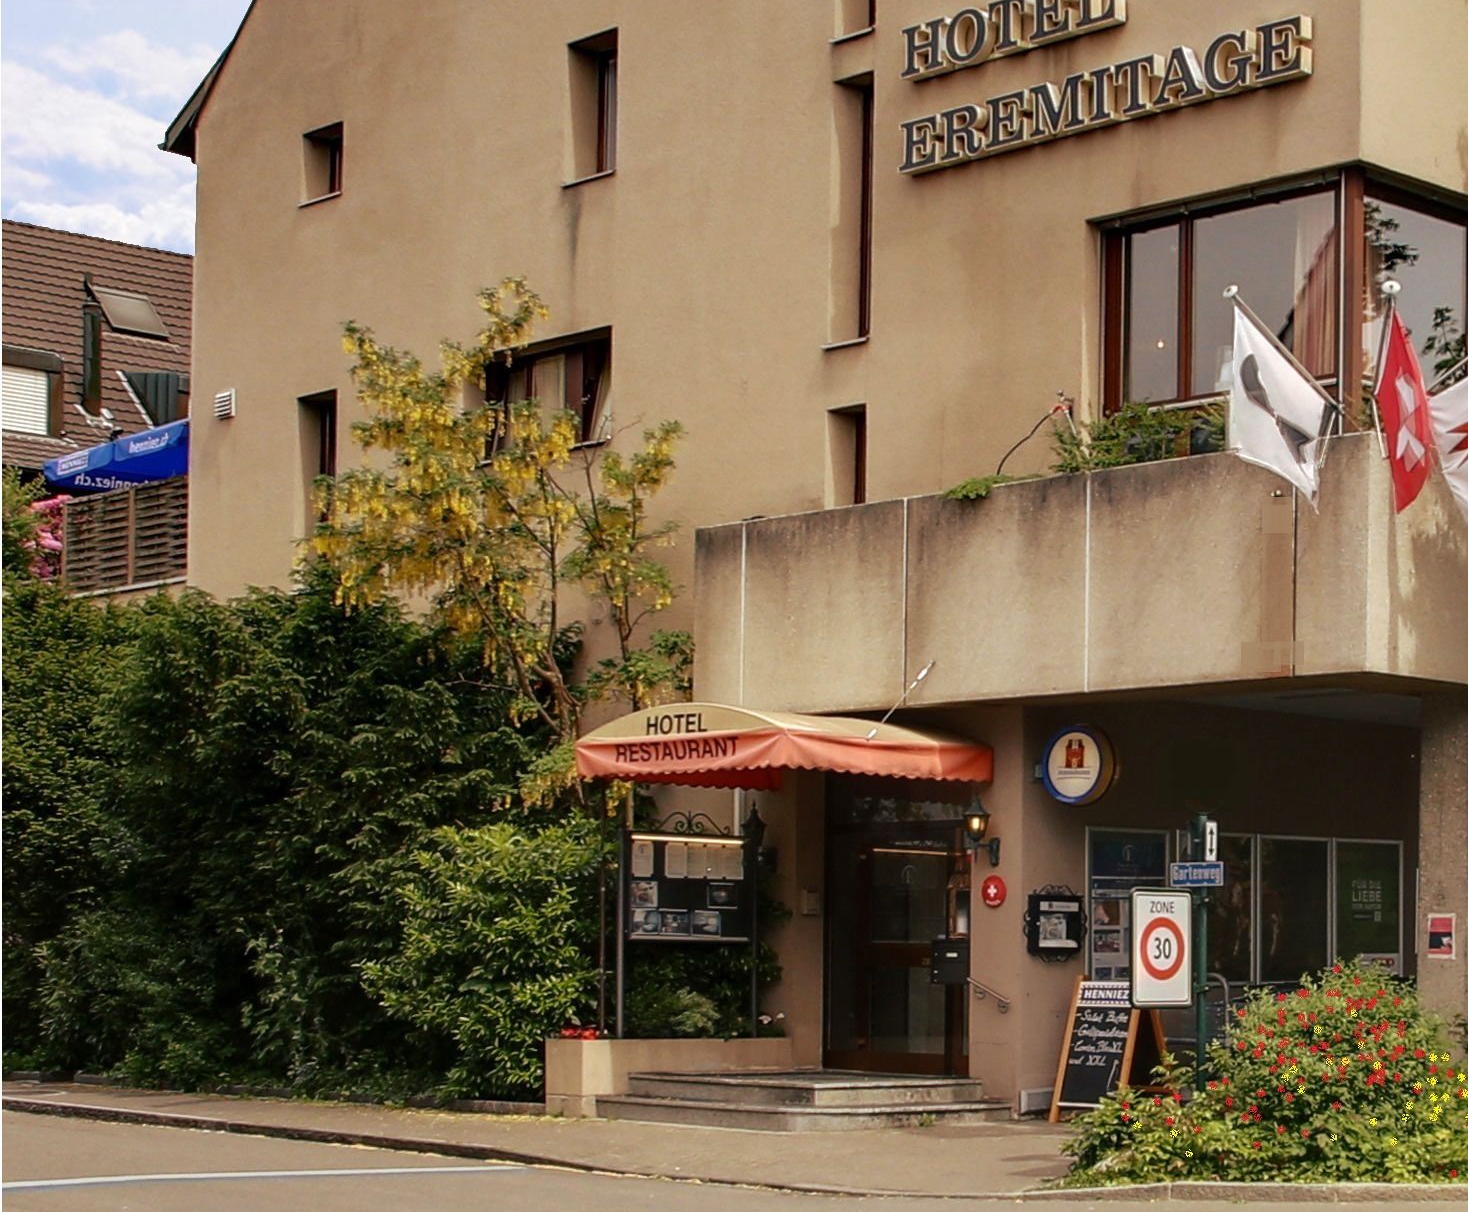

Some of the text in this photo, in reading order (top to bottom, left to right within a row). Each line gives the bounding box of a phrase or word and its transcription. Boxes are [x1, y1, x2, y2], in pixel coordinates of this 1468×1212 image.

[898, 14, 1314, 176] EREMITAGE
[646, 713, 708, 736] HOTEL
[615, 736, 739, 763] RESTAURANT
[1173, 866, 1221, 884] Gartenweg
[1352, 890, 1381, 902] LIEBE
[1150, 900, 1175, 914] ZONE
[1153, 936, 1172, 960] 30
[1083, 988, 1130, 1000] HENNIEZ
